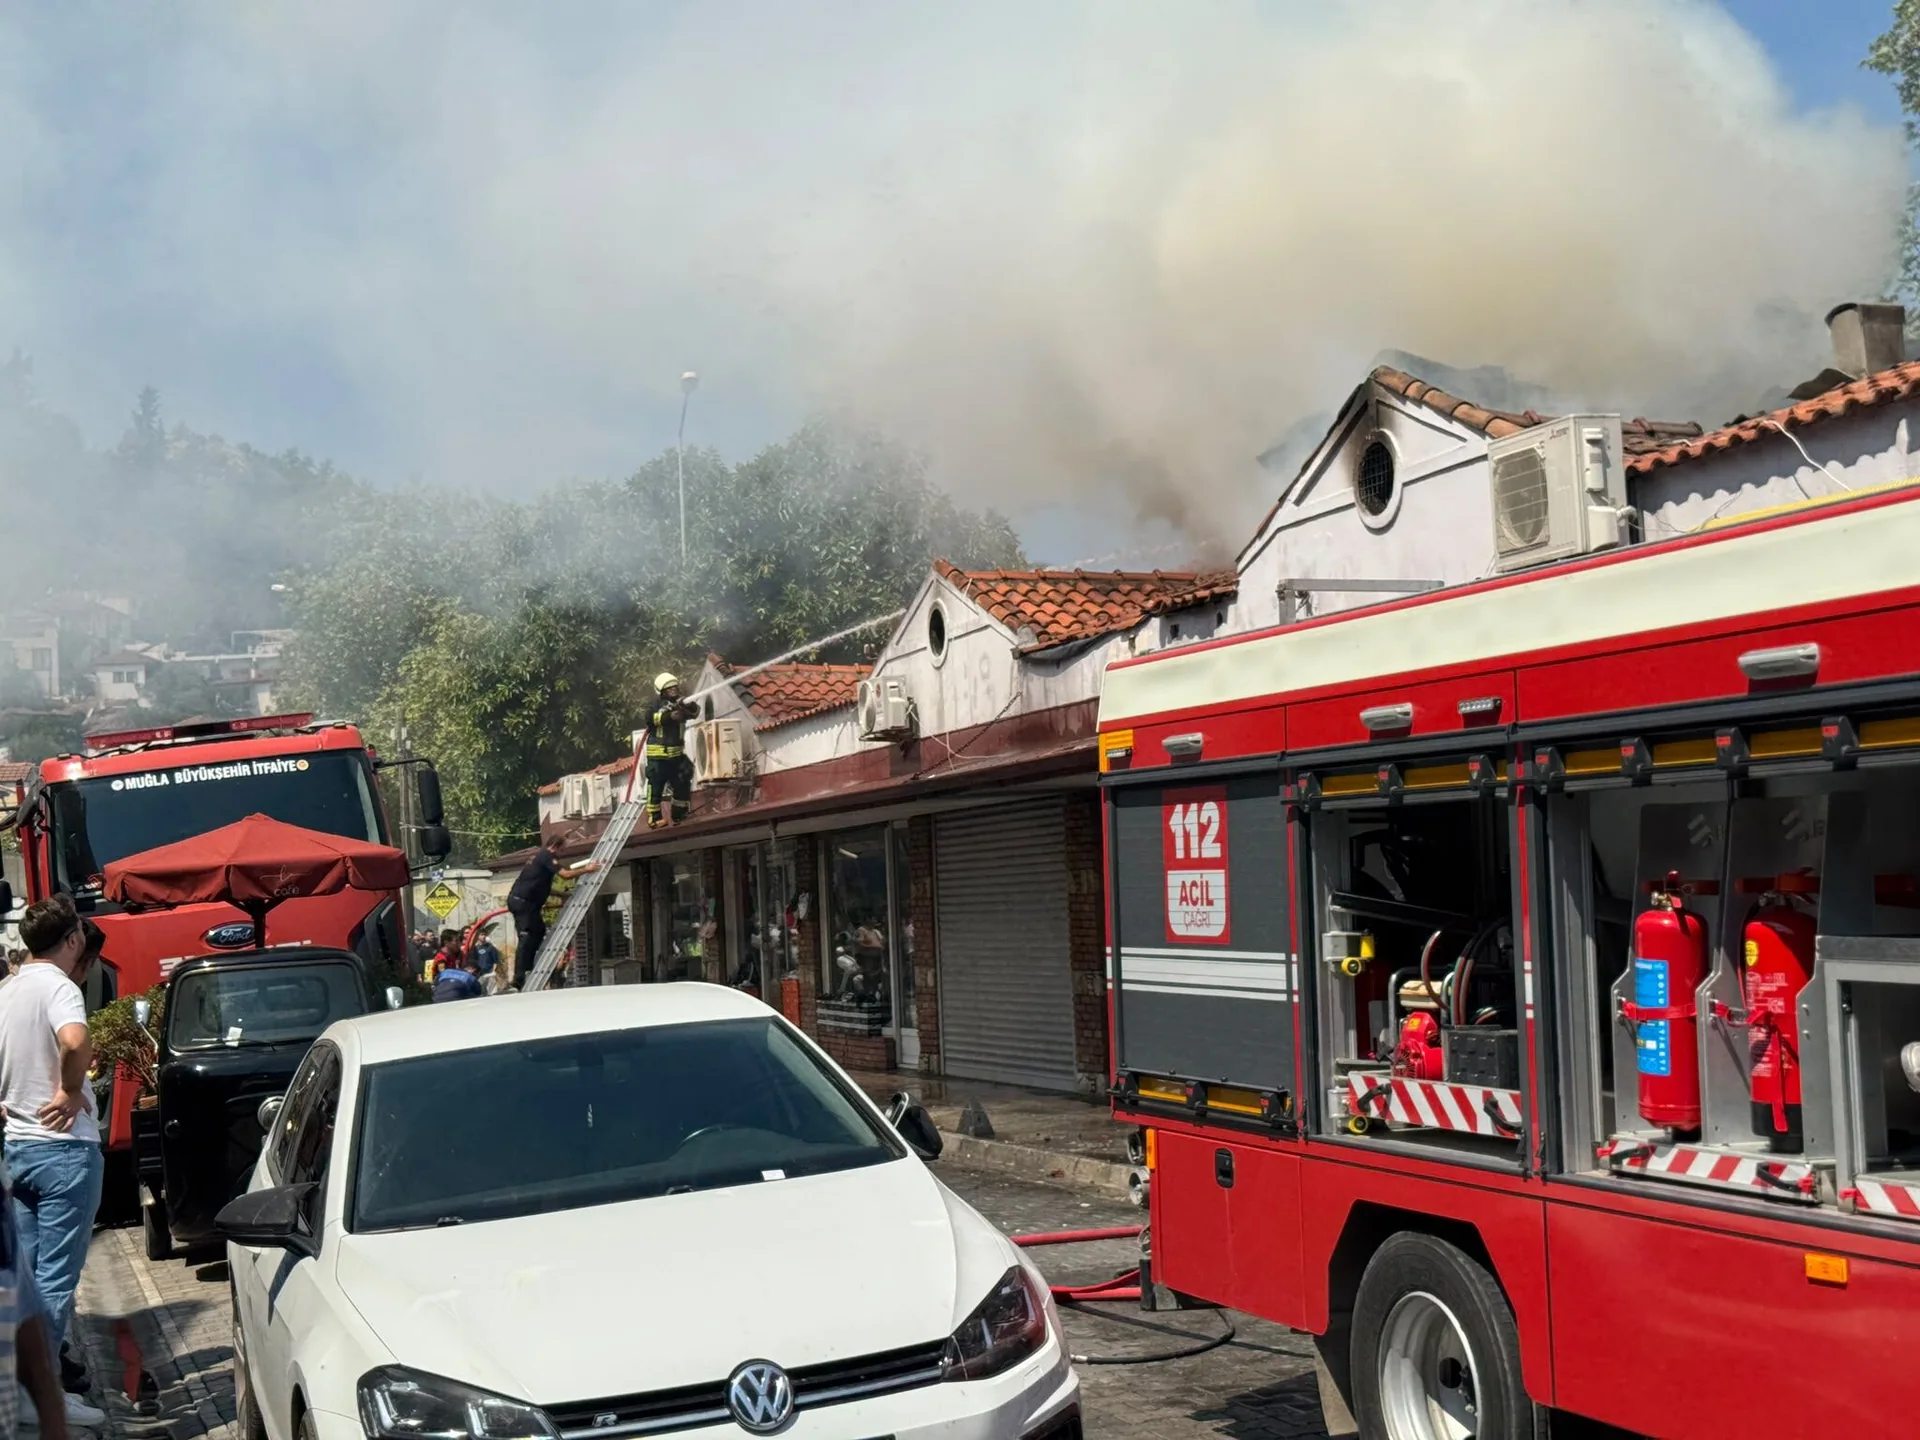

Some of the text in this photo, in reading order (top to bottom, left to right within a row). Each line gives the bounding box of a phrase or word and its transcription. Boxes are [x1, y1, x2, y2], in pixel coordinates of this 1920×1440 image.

[125, 759, 297, 790] MUĞLA BÜYÜKŞEHİR İTFAİYE
[1168, 801, 1222, 859] 112
[1178, 873, 1214, 907] ACİL
[1183, 908, 1211, 932] ÇAĞRI
[219, 927, 252, 943] Ford
[592, 1411, 620, 1428] R
